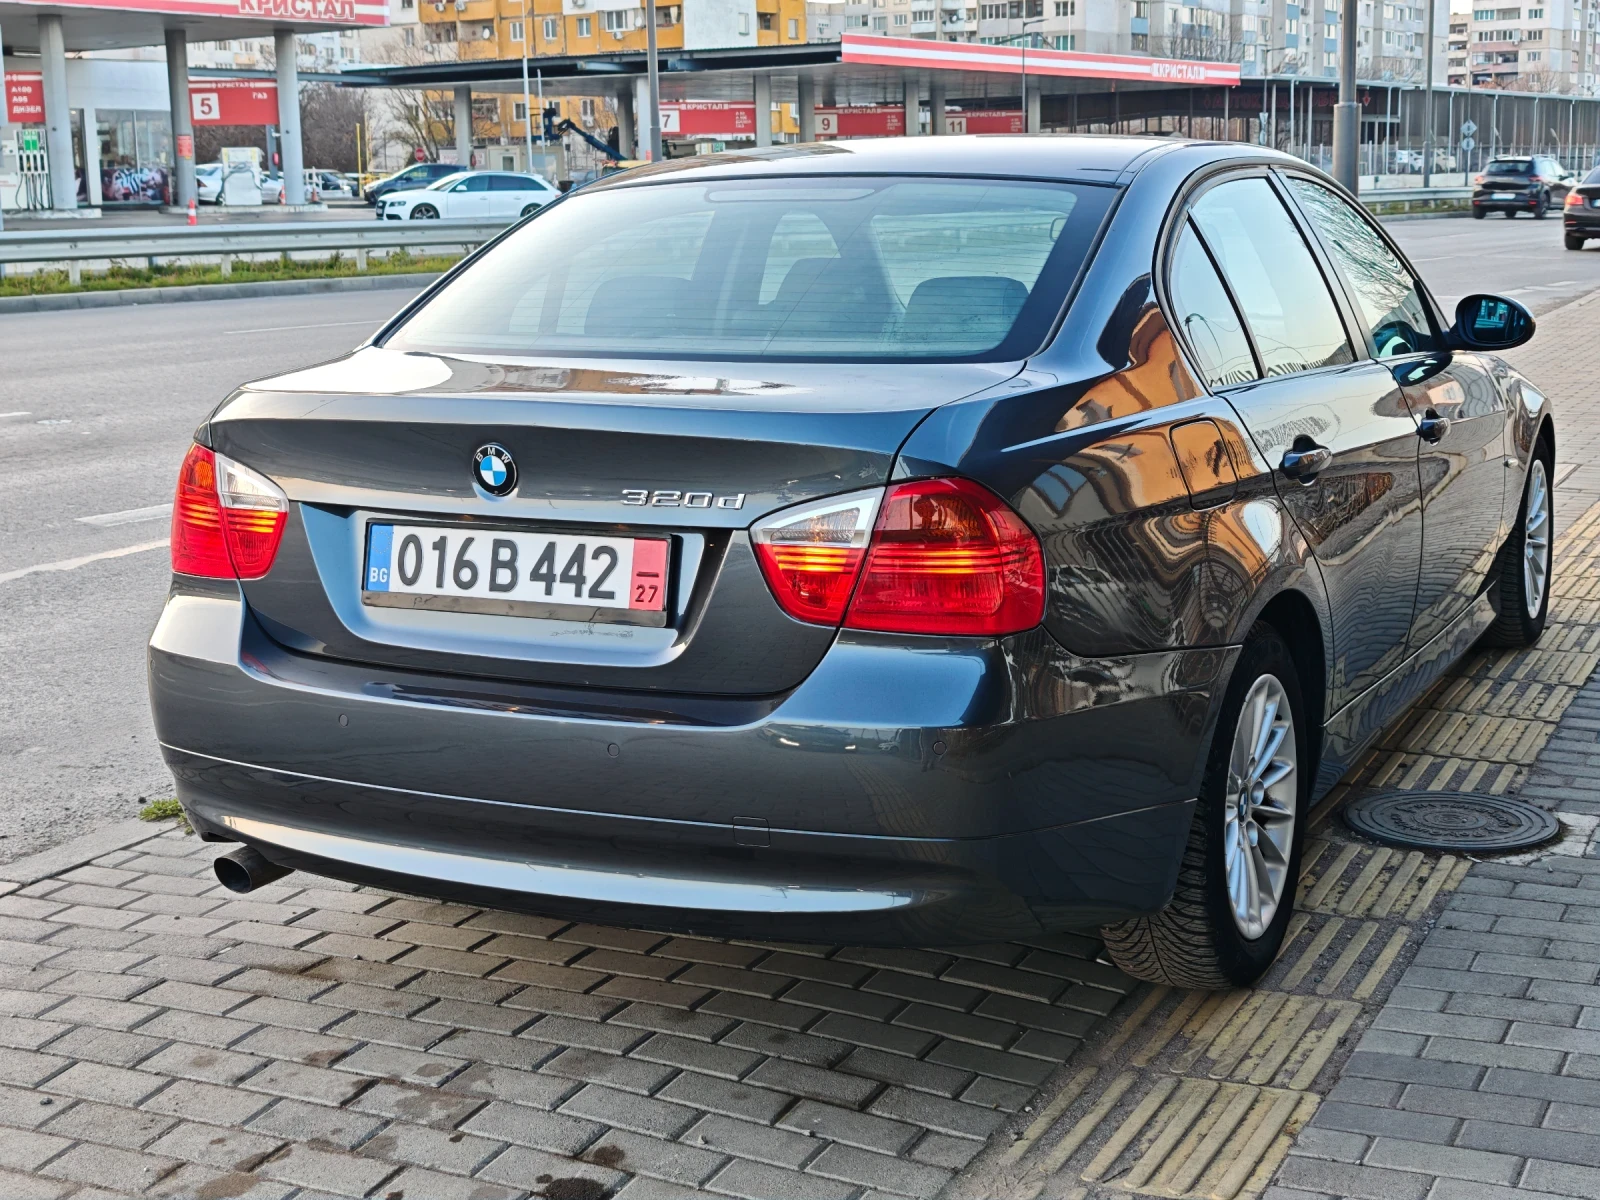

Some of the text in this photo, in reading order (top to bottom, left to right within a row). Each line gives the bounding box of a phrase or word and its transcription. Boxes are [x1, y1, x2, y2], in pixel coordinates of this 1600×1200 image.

[200, 97, 213, 116] 5
[661, 114, 671, 129] 7
[821, 117, 831, 131] 9
[949, 120, 963, 133] 11
[475, 446, 512, 464] BMW
[620, 489, 746, 510] 320d
[369, 567, 388, 583] BG
[634, 584, 658, 603] 27
